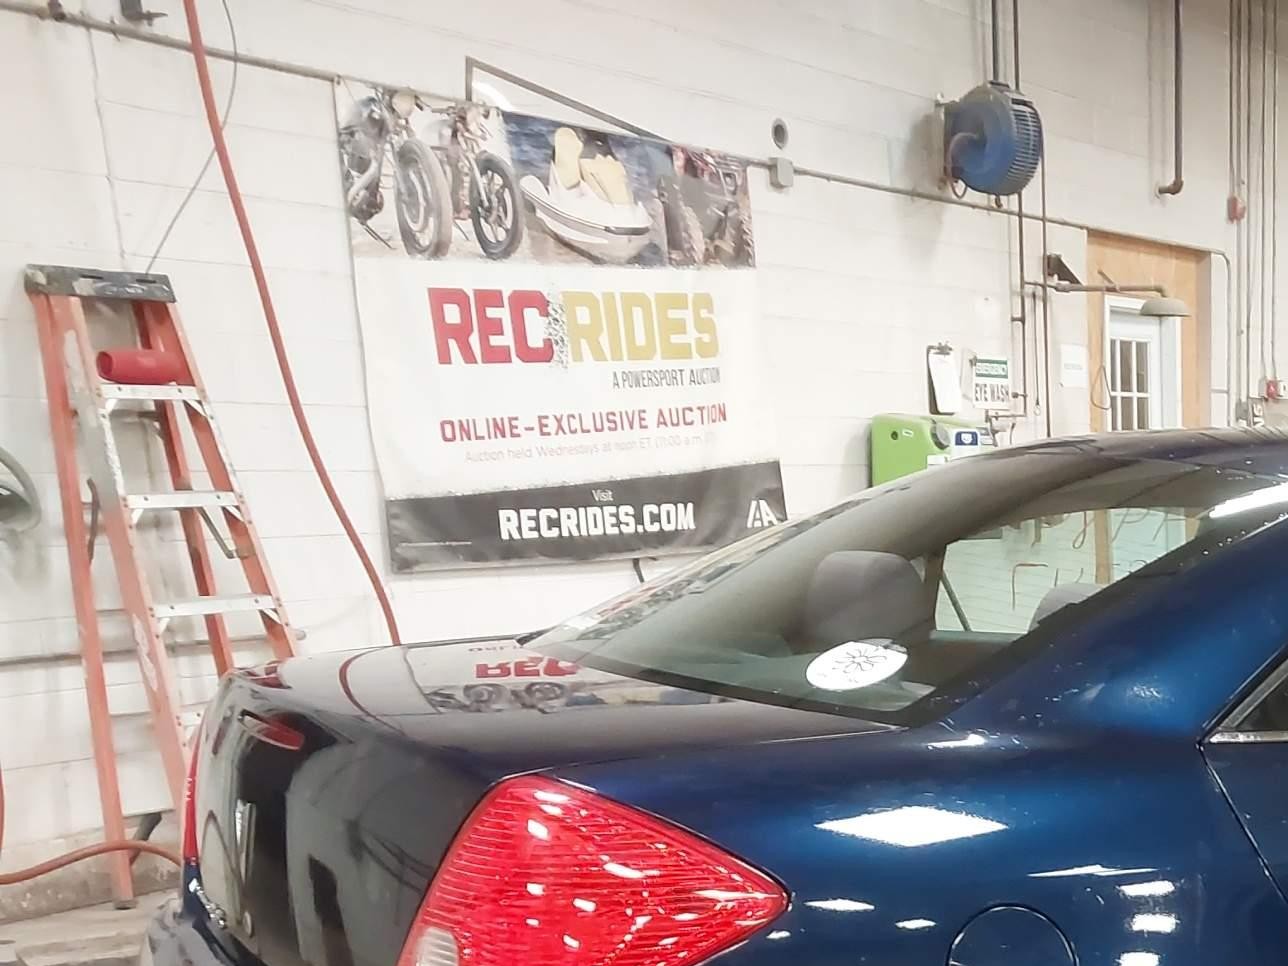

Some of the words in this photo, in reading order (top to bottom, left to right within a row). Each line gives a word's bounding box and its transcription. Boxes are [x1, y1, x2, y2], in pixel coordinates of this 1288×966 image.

[427, 287, 554, 364] REC
[560, 290, 720, 363] RIDES
[621, 368, 686, 389] POWERSPORT
[689, 366, 721, 386] AUCTION
[440, 409, 648, 442] ONLINE-EXCLUSIVE
[656, 402, 727, 429] AUCTION
[592, 489, 613, 502] Visit
[498, 502, 696, 541] RECRIDES.COM
